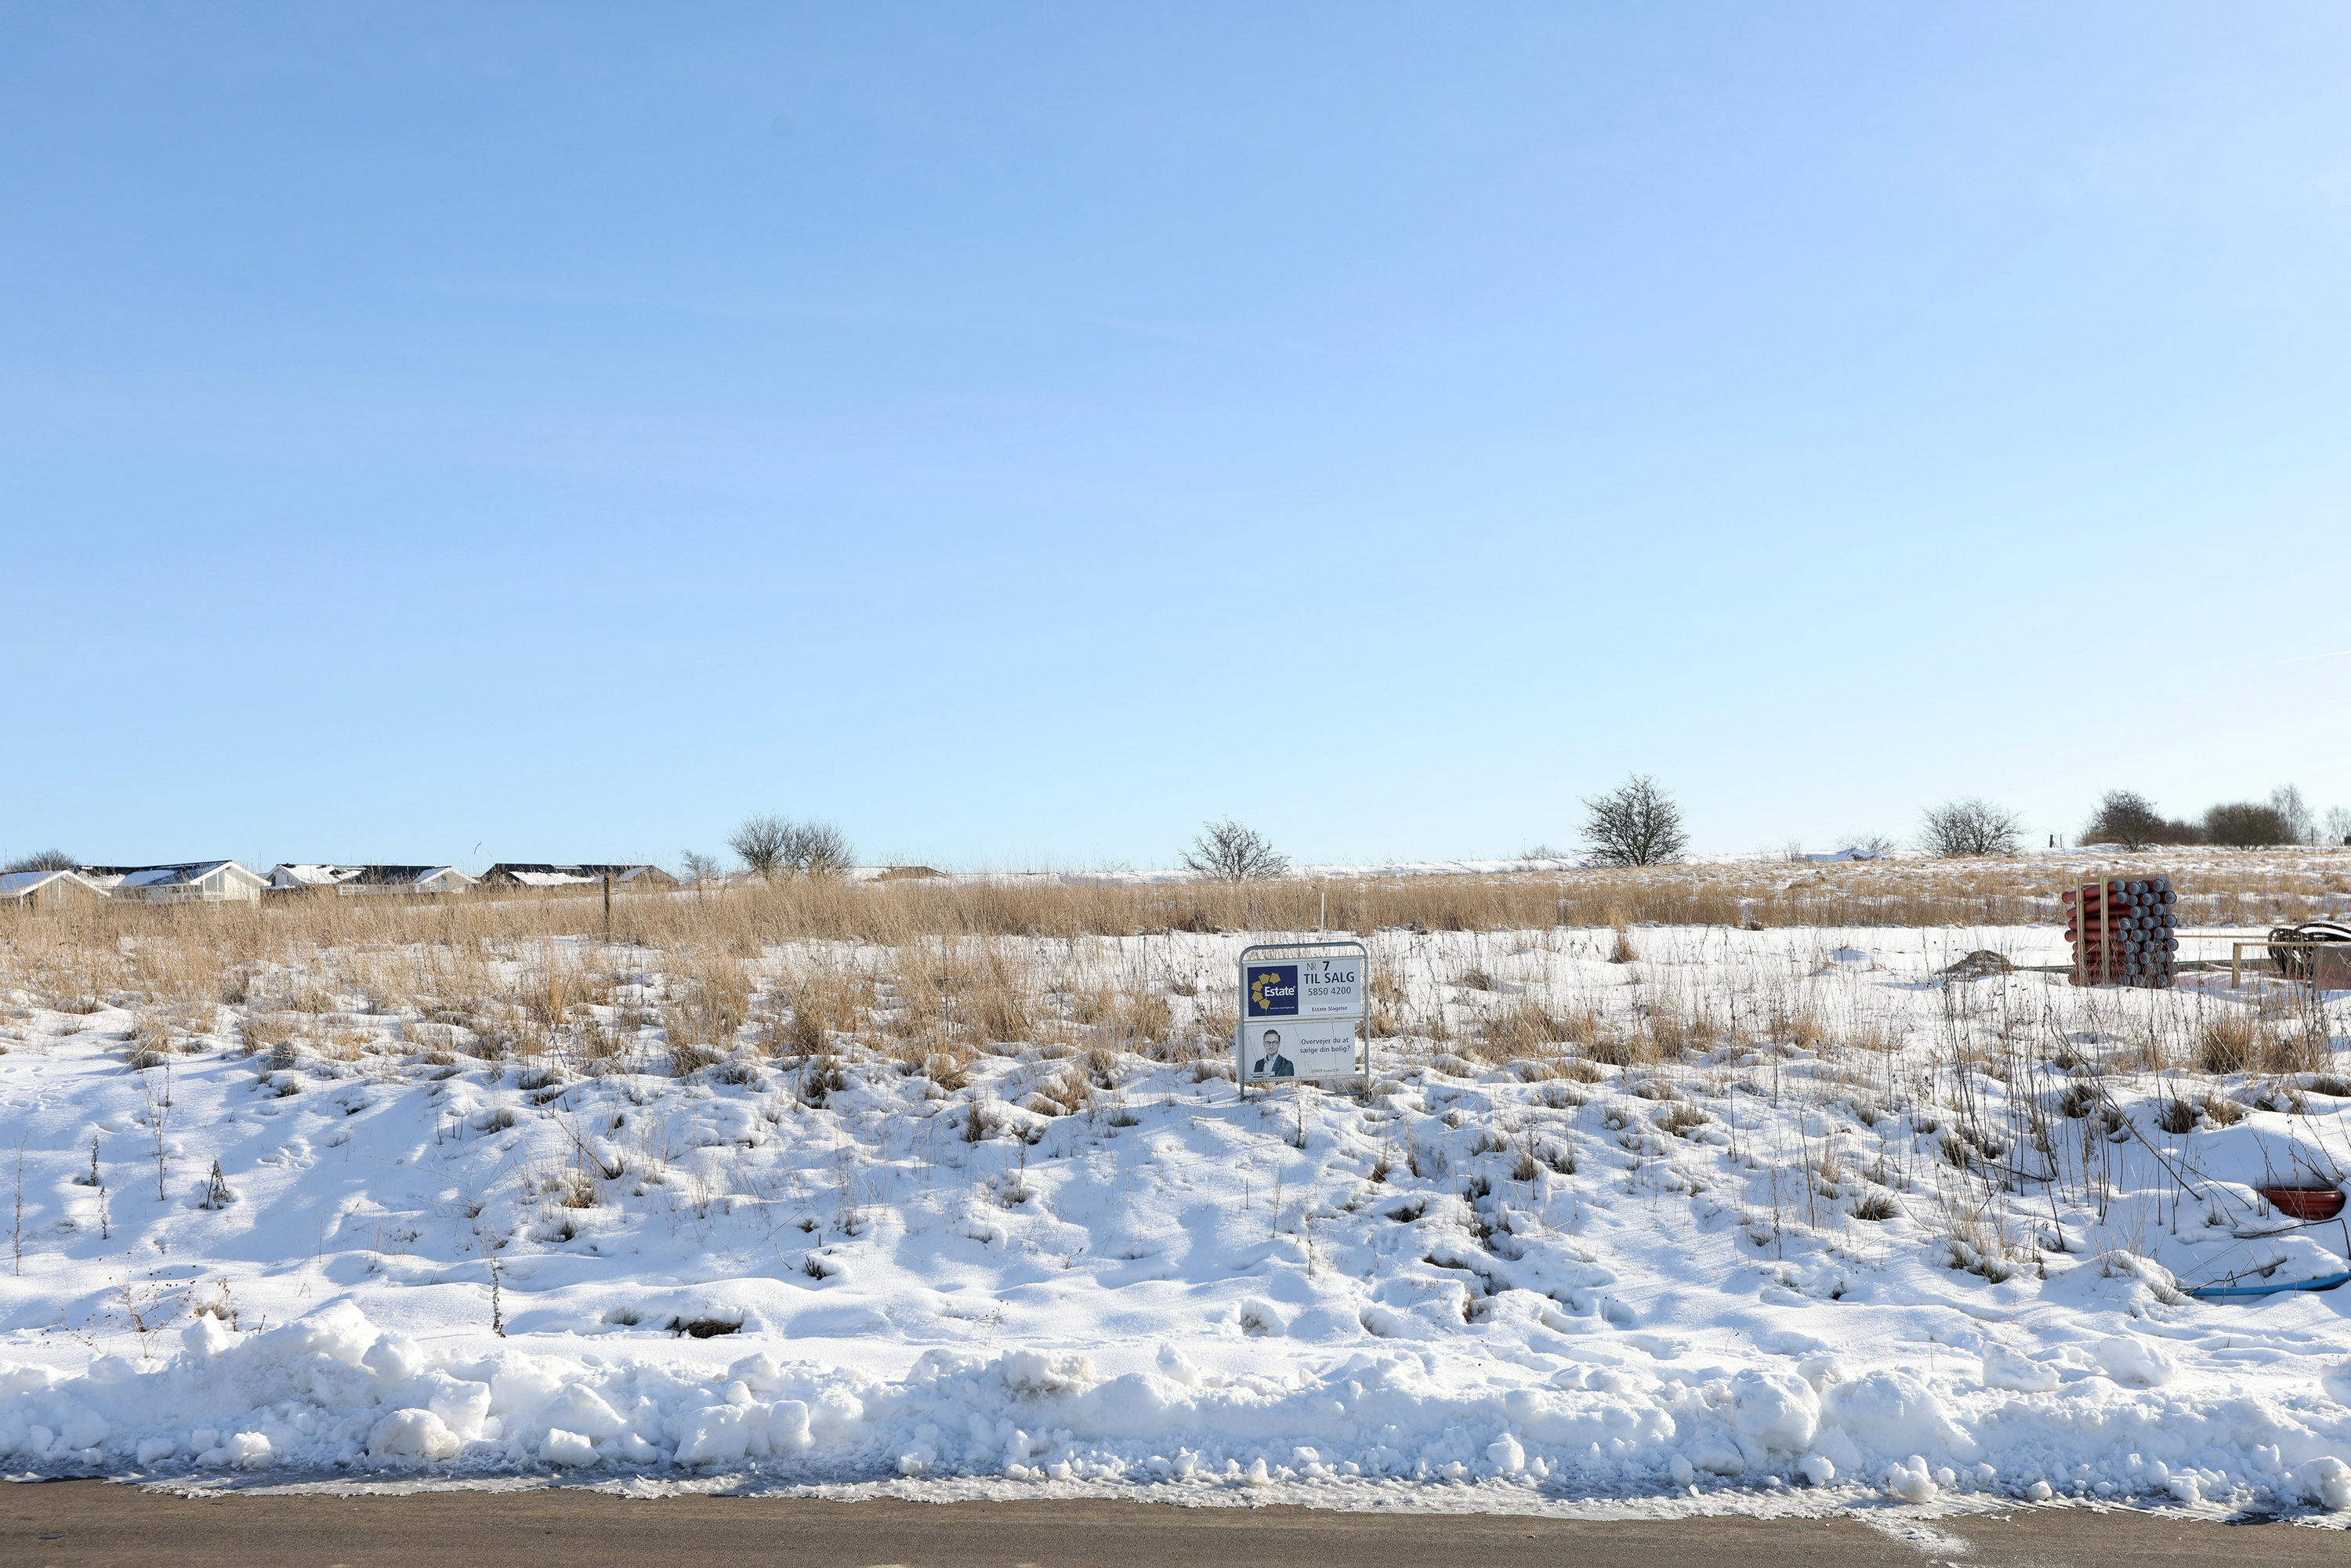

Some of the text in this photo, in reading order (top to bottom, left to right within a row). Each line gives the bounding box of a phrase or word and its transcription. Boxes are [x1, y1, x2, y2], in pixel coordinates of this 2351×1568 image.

[1323, 961, 1330, 971] 7
[1304, 972, 1355, 984] TIL SALG
[1264, 986, 1295, 996] Estate
[1308, 986, 1351, 996] 5850 4200
[1331, 1045, 1350, 1054] bolig?
